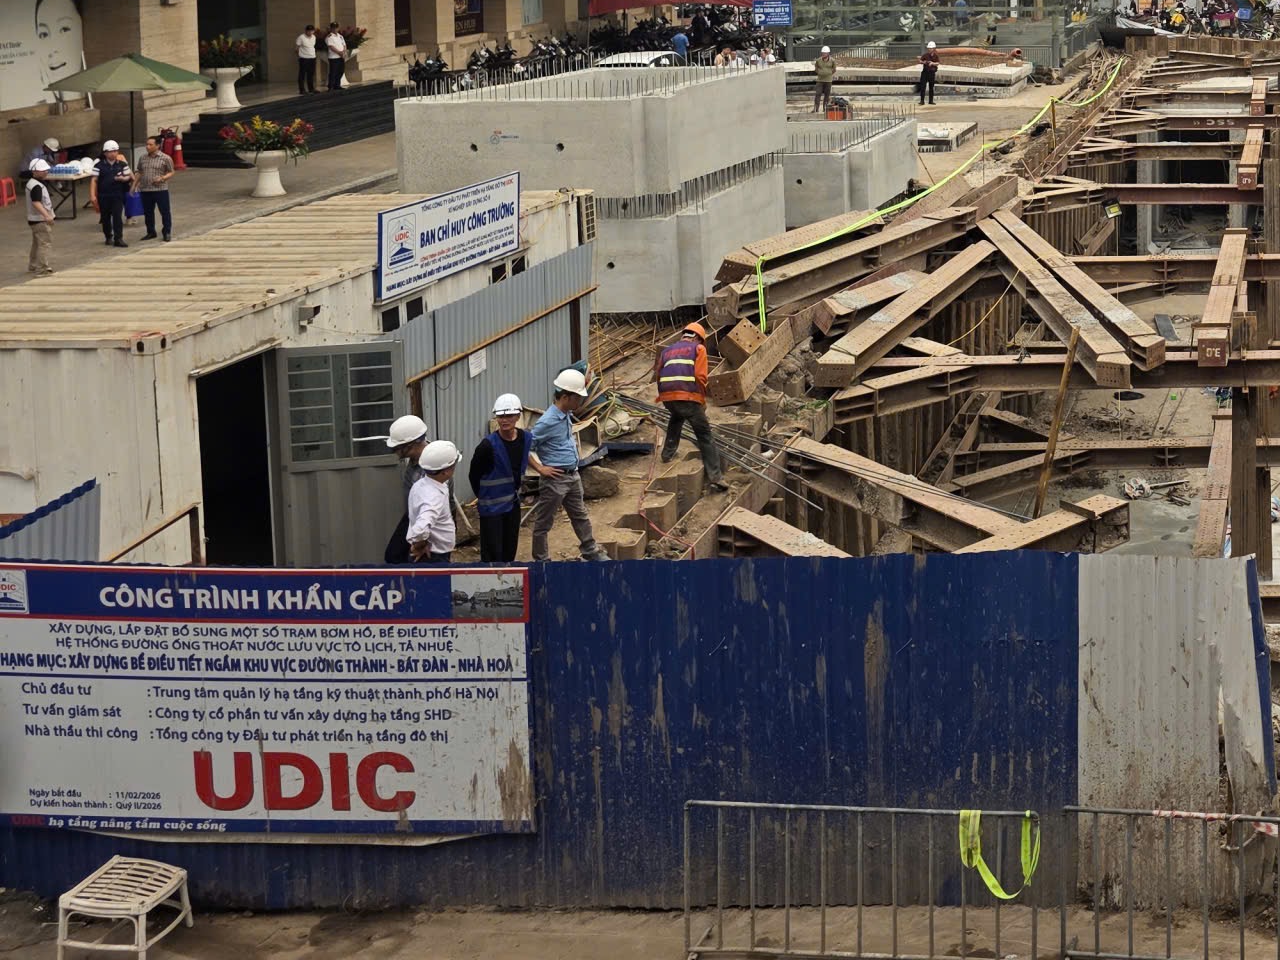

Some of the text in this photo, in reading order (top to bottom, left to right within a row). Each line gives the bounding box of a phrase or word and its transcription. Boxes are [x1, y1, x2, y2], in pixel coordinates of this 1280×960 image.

[420, 228, 436, 248] BAN
[451, 216, 466, 237] HUY
[467, 211, 487, 231] CÔNG
[487, 201, 514, 224] TRƯỜNG
[394, 230, 410, 242] UDIC
[0, 583, 17, 591] DIC
[99, 582, 404, 610] CÔNG TRÌNH KHẨN CẤP
[49, 623, 73, 635] XÂY
[75, 624, 117, 636] DỰNG,
[119, 623, 142, 636] LẮP
[144, 624, 170, 638] ĐẶT
[192, 626, 228, 637] SUNG
[231, 625, 260, 639] MỘT
[262, 625, 280, 638] SỐ
[281, 627, 317, 640] TRẠM
[320, 627, 350, 638] BƠM
[56, 637, 73, 650] HỆ
[75, 636, 119, 649] THỐNG
[121, 638, 169, 650] ĐƯỜNG
[203, 639, 245, 651] THOÁT
[247, 640, 285, 652] NƯỚC
[287, 641, 313, 652] LƯU
[315, 642, 342, 653] VỰC
[344, 640, 362, 652] TÔ
[364, 642, 397, 654] LỊCH,
[399, 639, 414, 652] TẢ
[418, 640, 454, 653] NHUỆ
[0, 653, 34, 670] HẠNG
[37, 655, 67, 671] MỤC:
[69, 652, 91, 669] XÂY
[93, 654, 129, 672] DỰNG
[147, 654, 176, 671] ĐIỀU
[177, 654, 203, 671] TIẾT
[205, 654, 242, 672] NGẦM
[243, 658, 269, 672] KHU
[270, 657, 297, 674] VỰC
[298, 656, 344, 672] ĐƯỜNG
[345, 656, 388, 673] THÀNH
[397, 656, 420, 673] BÁT
[422, 656, 449, 673] ĐÀN
[458, 656, 485, 673] NHÀ
[21, 682, 92, 695] Chủ đầu tư
[152, 686, 500, 702] Trung tâm quản lý hạ tầng kỹ thuật thành phố Hà Nội
[23, 702, 122, 718] Tư vấn giám sát
[155, 707, 190, 721] Công
[192, 709, 206, 721] ty
[228, 706, 260, 722] phần
[263, 709, 279, 720] tư
[281, 707, 305, 720] vấn
[307, 709, 329, 723] xây
[333, 709, 367, 723] dựng
[370, 709, 387, 723] hạ
[390, 708, 421, 723] tầng
[424, 709, 452, 721] SHD
[25, 723, 139, 740] Nhà thầu thi công
[191, 728, 224, 743] công
[226, 730, 240, 743] ty
[272, 730, 287, 741] tư
[290, 729, 319, 744] phát
[357, 730, 373, 744] hạ
[376, 729, 406, 744] tầng
[410, 729, 427, 742] đô
[430, 730, 449, 743] thị
[193, 750, 416, 813] UDIC
[29, 788, 50, 798] Ngày
[51, 788, 65, 798] bắt
[115, 791, 162, 800] 11/02/2026
[30, 799, 42, 809] Dự
[43, 798, 60, 808] kiến
[61, 799, 82, 809] hoàn
[83, 800, 107, 809] thành
[115, 801, 133, 811] Quý
[48, 817, 64, 828] hạ
[68, 816, 97, 830] tầng
[100, 818, 133, 830] nâng
[135, 818, 161, 830] tầm
[163, 820, 195, 832] cuộc
[196, 818, 227, 833] sống
